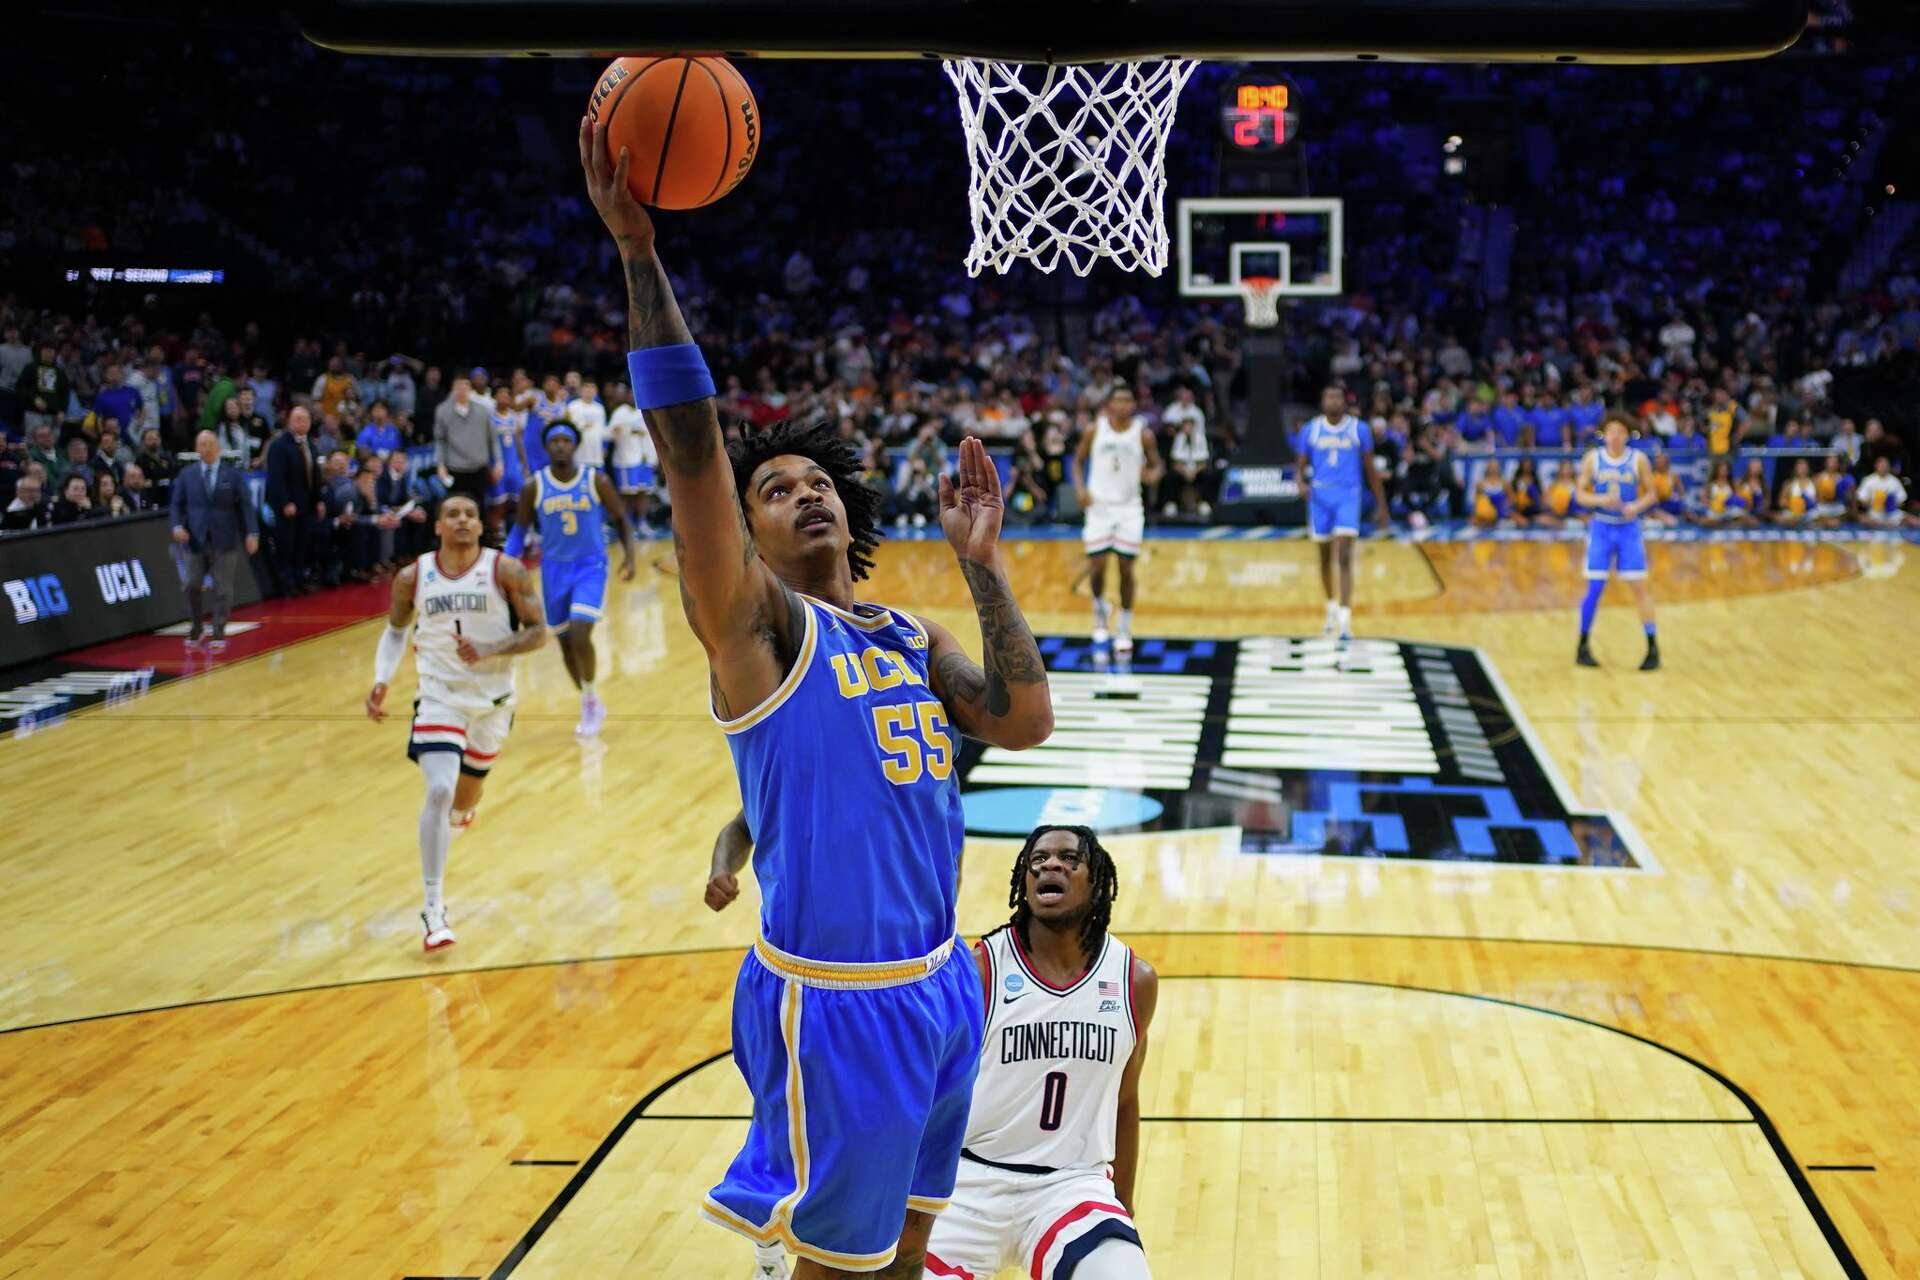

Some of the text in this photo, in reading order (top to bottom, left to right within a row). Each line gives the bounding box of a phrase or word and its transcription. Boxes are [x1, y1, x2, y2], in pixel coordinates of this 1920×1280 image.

[1234, 108, 1285, 145] 27
[561, 511, 578, 536] 3
[95, 559, 151, 605] UCLA
[829, 645, 928, 699] UCL
[871, 700, 952, 786] 55
[1001, 1021, 1118, 1065] CONNECTICUT
[1039, 1071, 1068, 1131] 0
